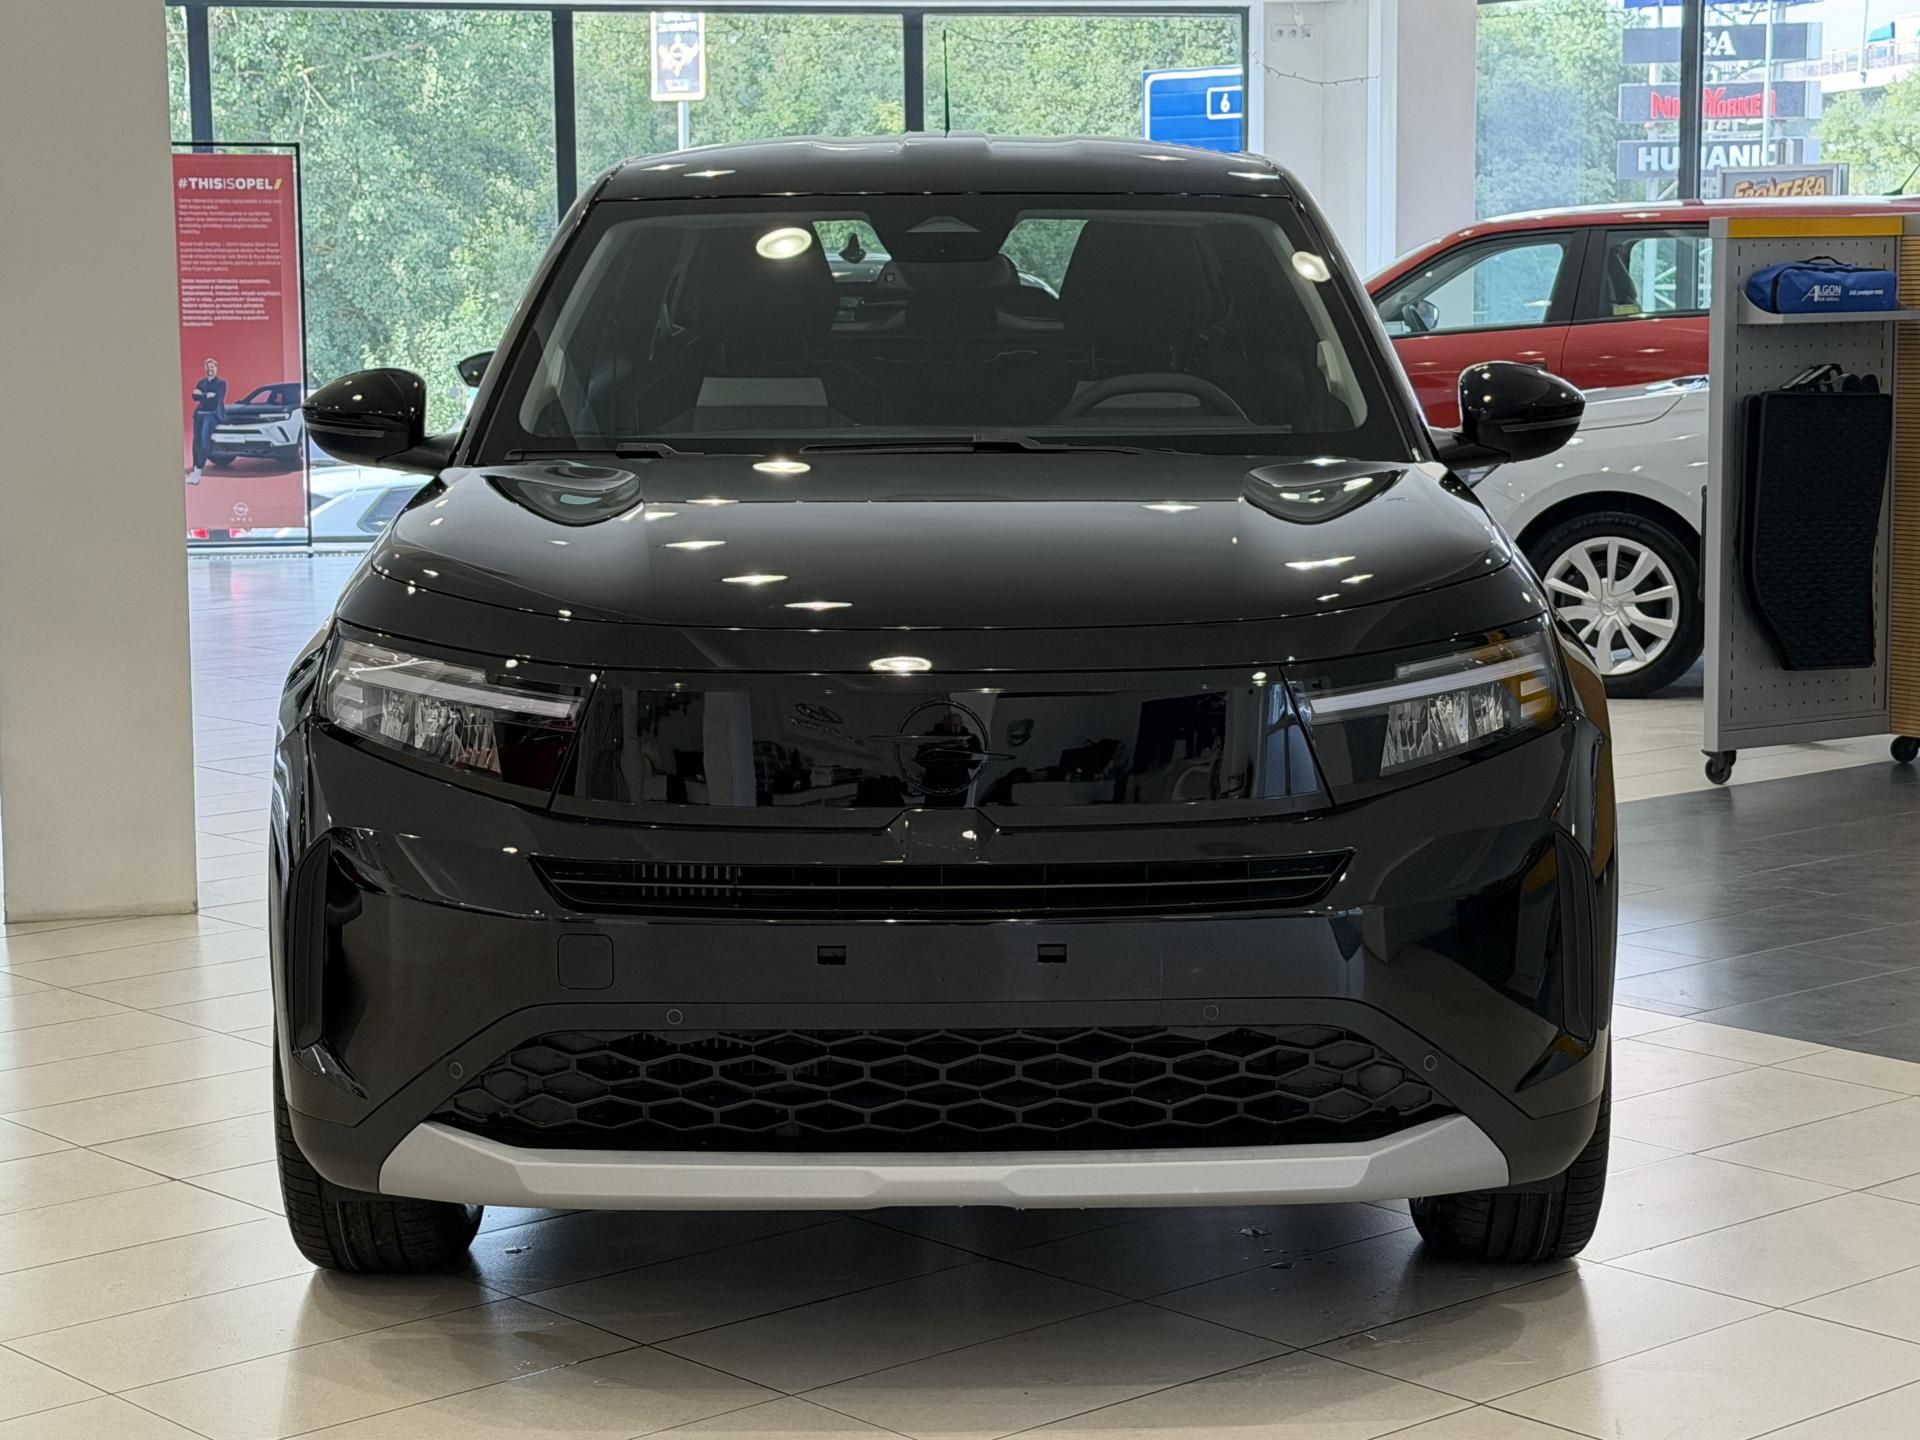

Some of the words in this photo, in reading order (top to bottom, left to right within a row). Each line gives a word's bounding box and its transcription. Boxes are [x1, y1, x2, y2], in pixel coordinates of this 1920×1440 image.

[1703, 32, 1737, 56] &A
[1220, 93, 1231, 112] 6
[1638, 144, 1778, 171] HUANIC
